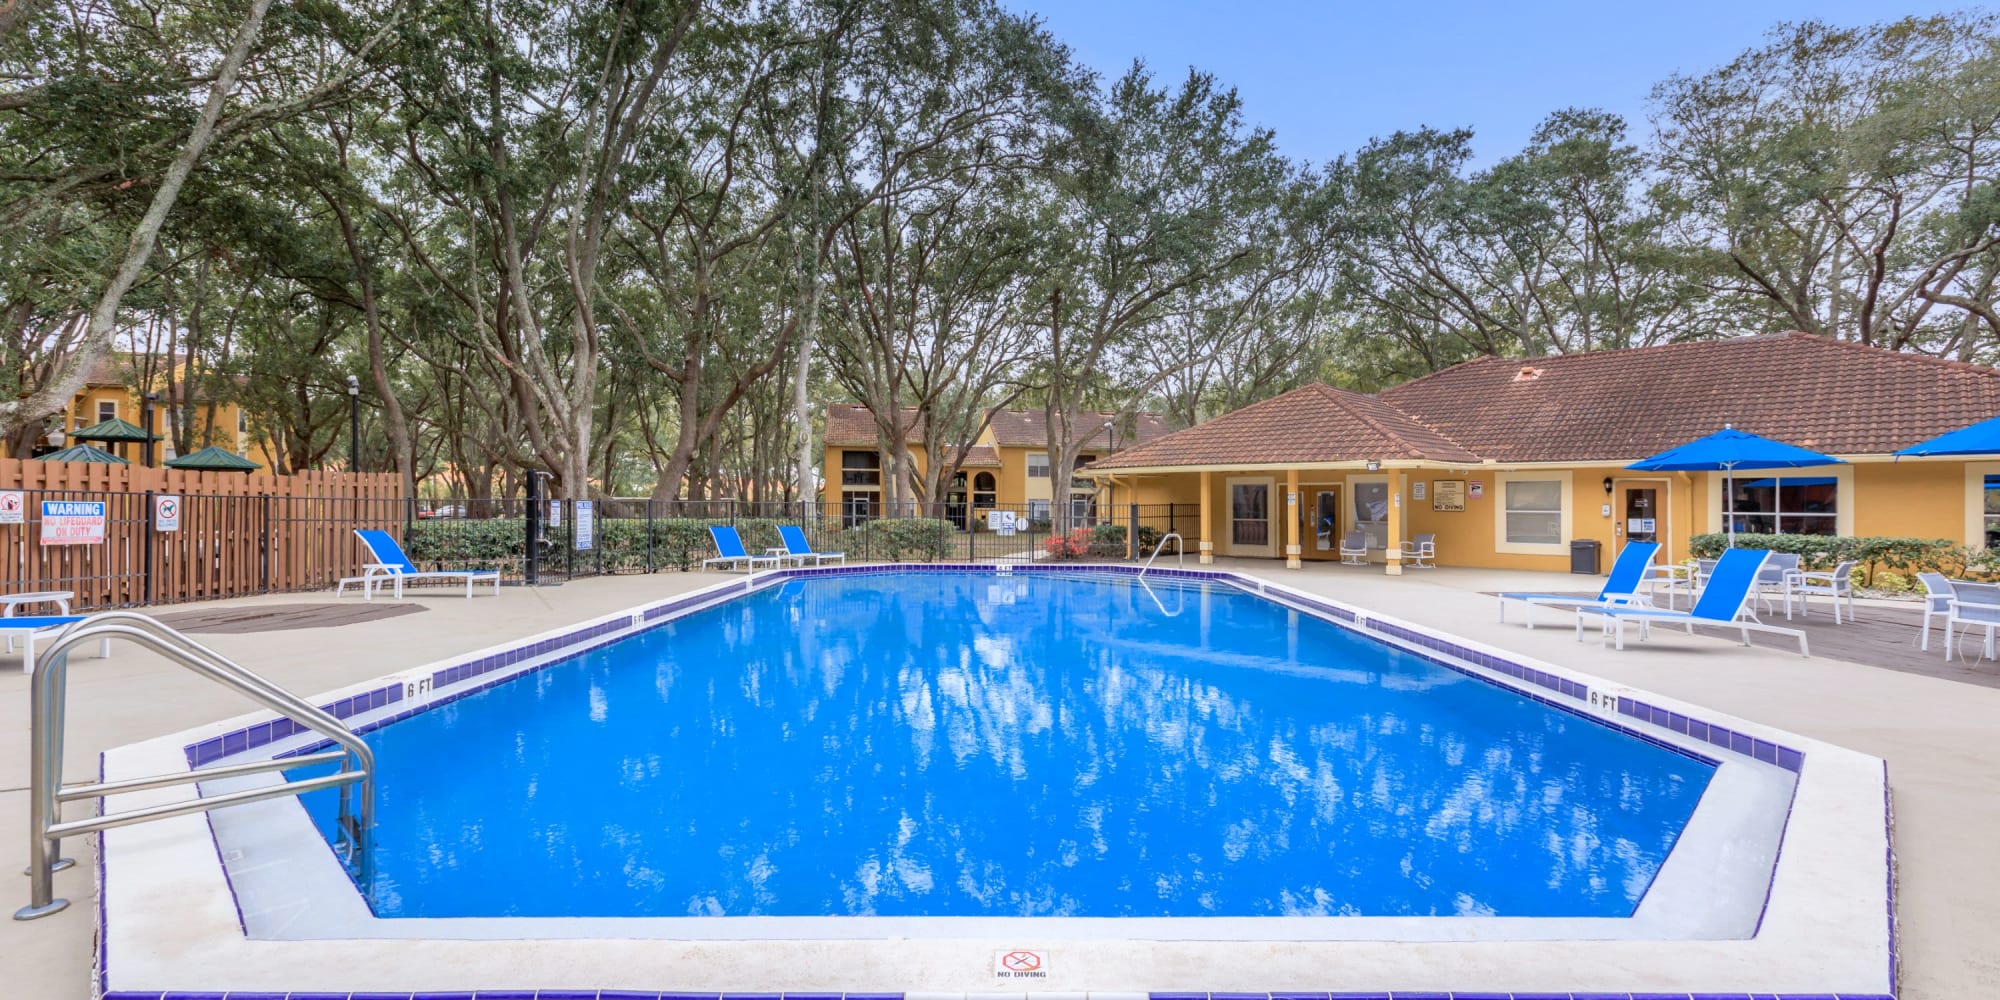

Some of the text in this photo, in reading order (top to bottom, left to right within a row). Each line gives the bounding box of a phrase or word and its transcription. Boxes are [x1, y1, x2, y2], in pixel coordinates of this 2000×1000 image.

[47, 503, 100, 515] WARNING
[44, 517, 102, 526] NO LIFEGUARD
[56, 527, 91, 536] ON DUTY
[408, 678, 431, 697] 6 FT
[1591, 691, 1616, 711] 6 FT
